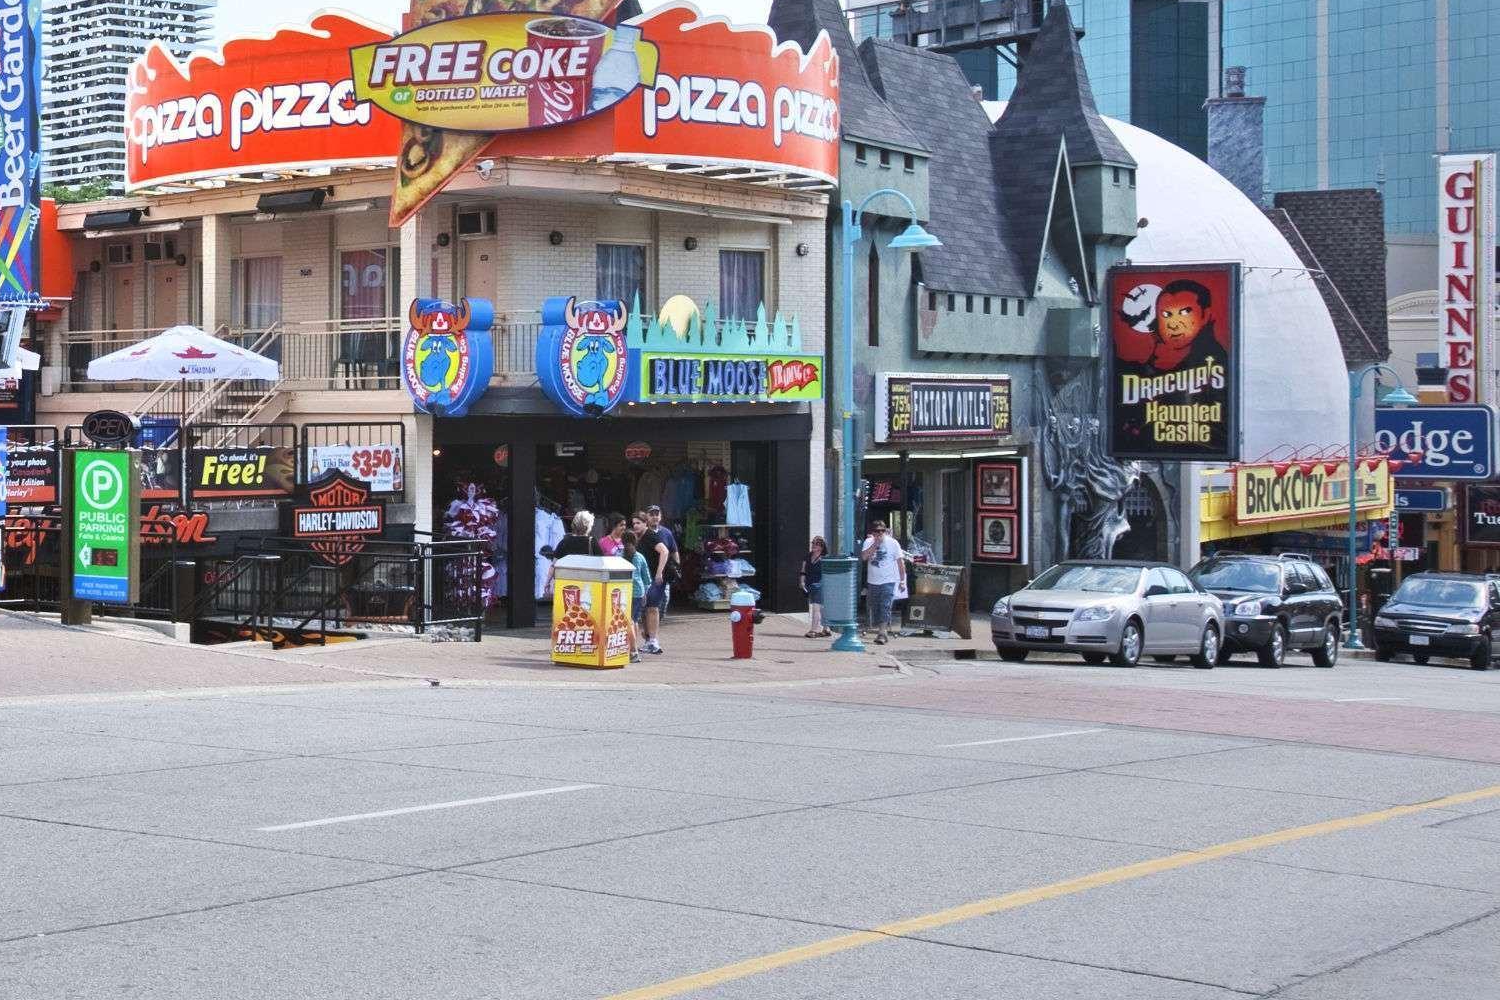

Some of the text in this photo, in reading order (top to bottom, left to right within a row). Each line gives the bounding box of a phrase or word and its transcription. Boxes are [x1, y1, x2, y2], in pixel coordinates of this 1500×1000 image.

[369, 42, 589, 83] FREE COKE
[394, 90, 410, 101] or
[415, 87, 475, 101] BOTTLED
[644, 73, 766, 137] pizza
[129, 79, 371, 165] pizza pizza
[405, 330, 426, 400] BLUE MOOSE
[562, 330, 584, 400] BLUE MOOSE
[654, 359, 701, 395] BLUE
[708, 360, 767, 395] MOOSE
[914, 391, 990, 426] FACTORY OUTLET
[1145, 401, 1221, 424] Haunted
[89, 418, 131, 436] OPEN
[893, 413, 910, 431] OFF
[994, 413, 1009, 429] OFF
[1154, 421, 1211, 442] Castle
[11, 458, 46, 468] your photo
[201, 455, 266, 486] Free!
[319, 485, 360, 506] MOTOR
[79, 512, 126, 524] PUBLIC
[79, 523, 125, 533] PARKING
[299, 510, 378, 531] HARLEY-DAVIDSON
[101, 534, 124, 542] Casino
[557, 630, 593, 644] FREE
[607, 631, 627, 648] FREE
